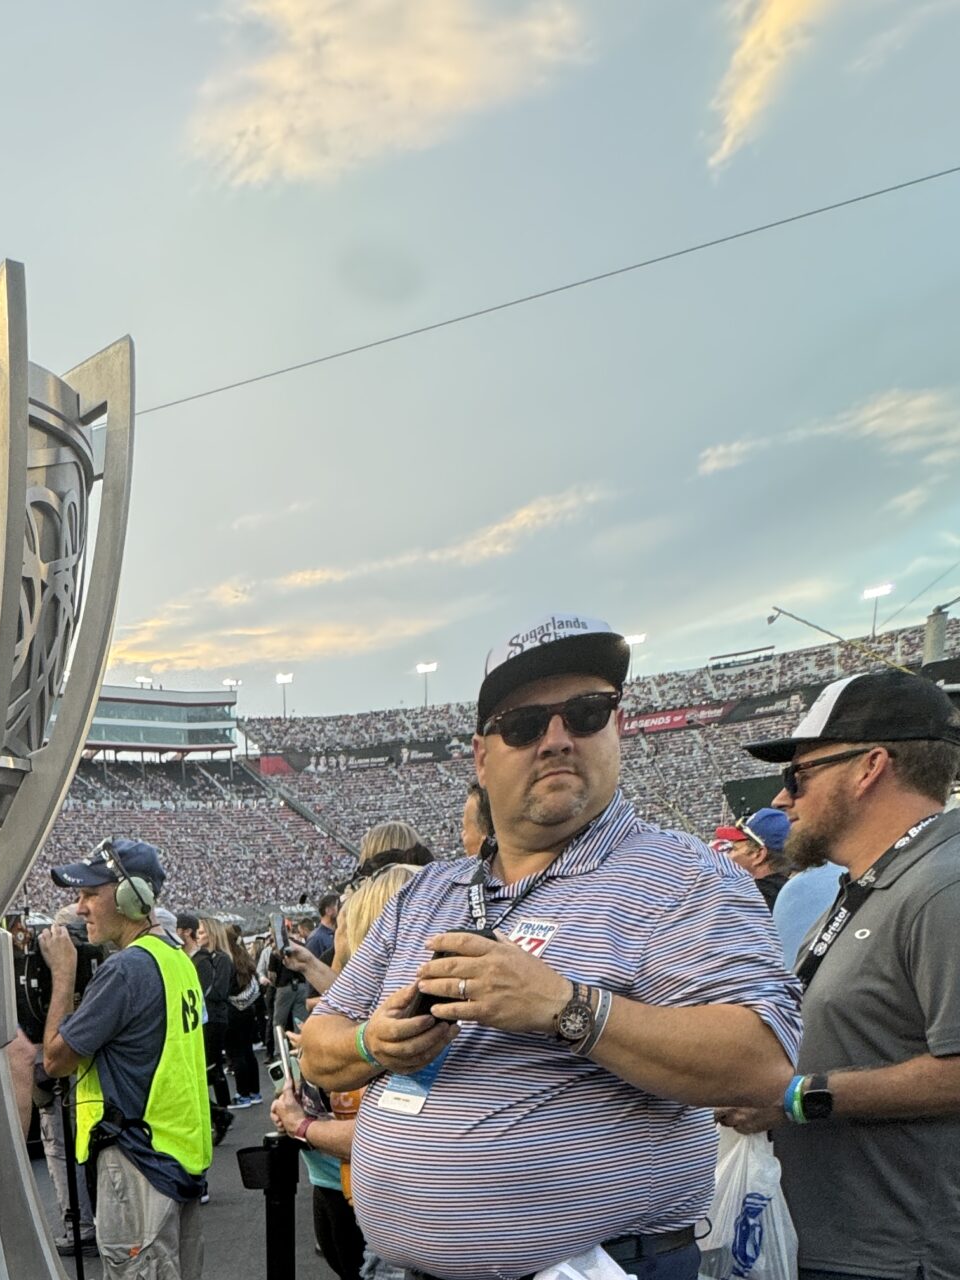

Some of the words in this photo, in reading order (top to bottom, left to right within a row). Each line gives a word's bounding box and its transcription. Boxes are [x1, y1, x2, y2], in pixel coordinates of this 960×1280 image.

[507, 617, 589, 660] Sugarlands
[624, 715, 671, 731] LEGENDS
[470, 884, 481, 918] Bristol
[519, 922, 555, 933] TRUMP
[822, 907, 847, 942] Bristol
[181, 989, 200, 1034] NB
